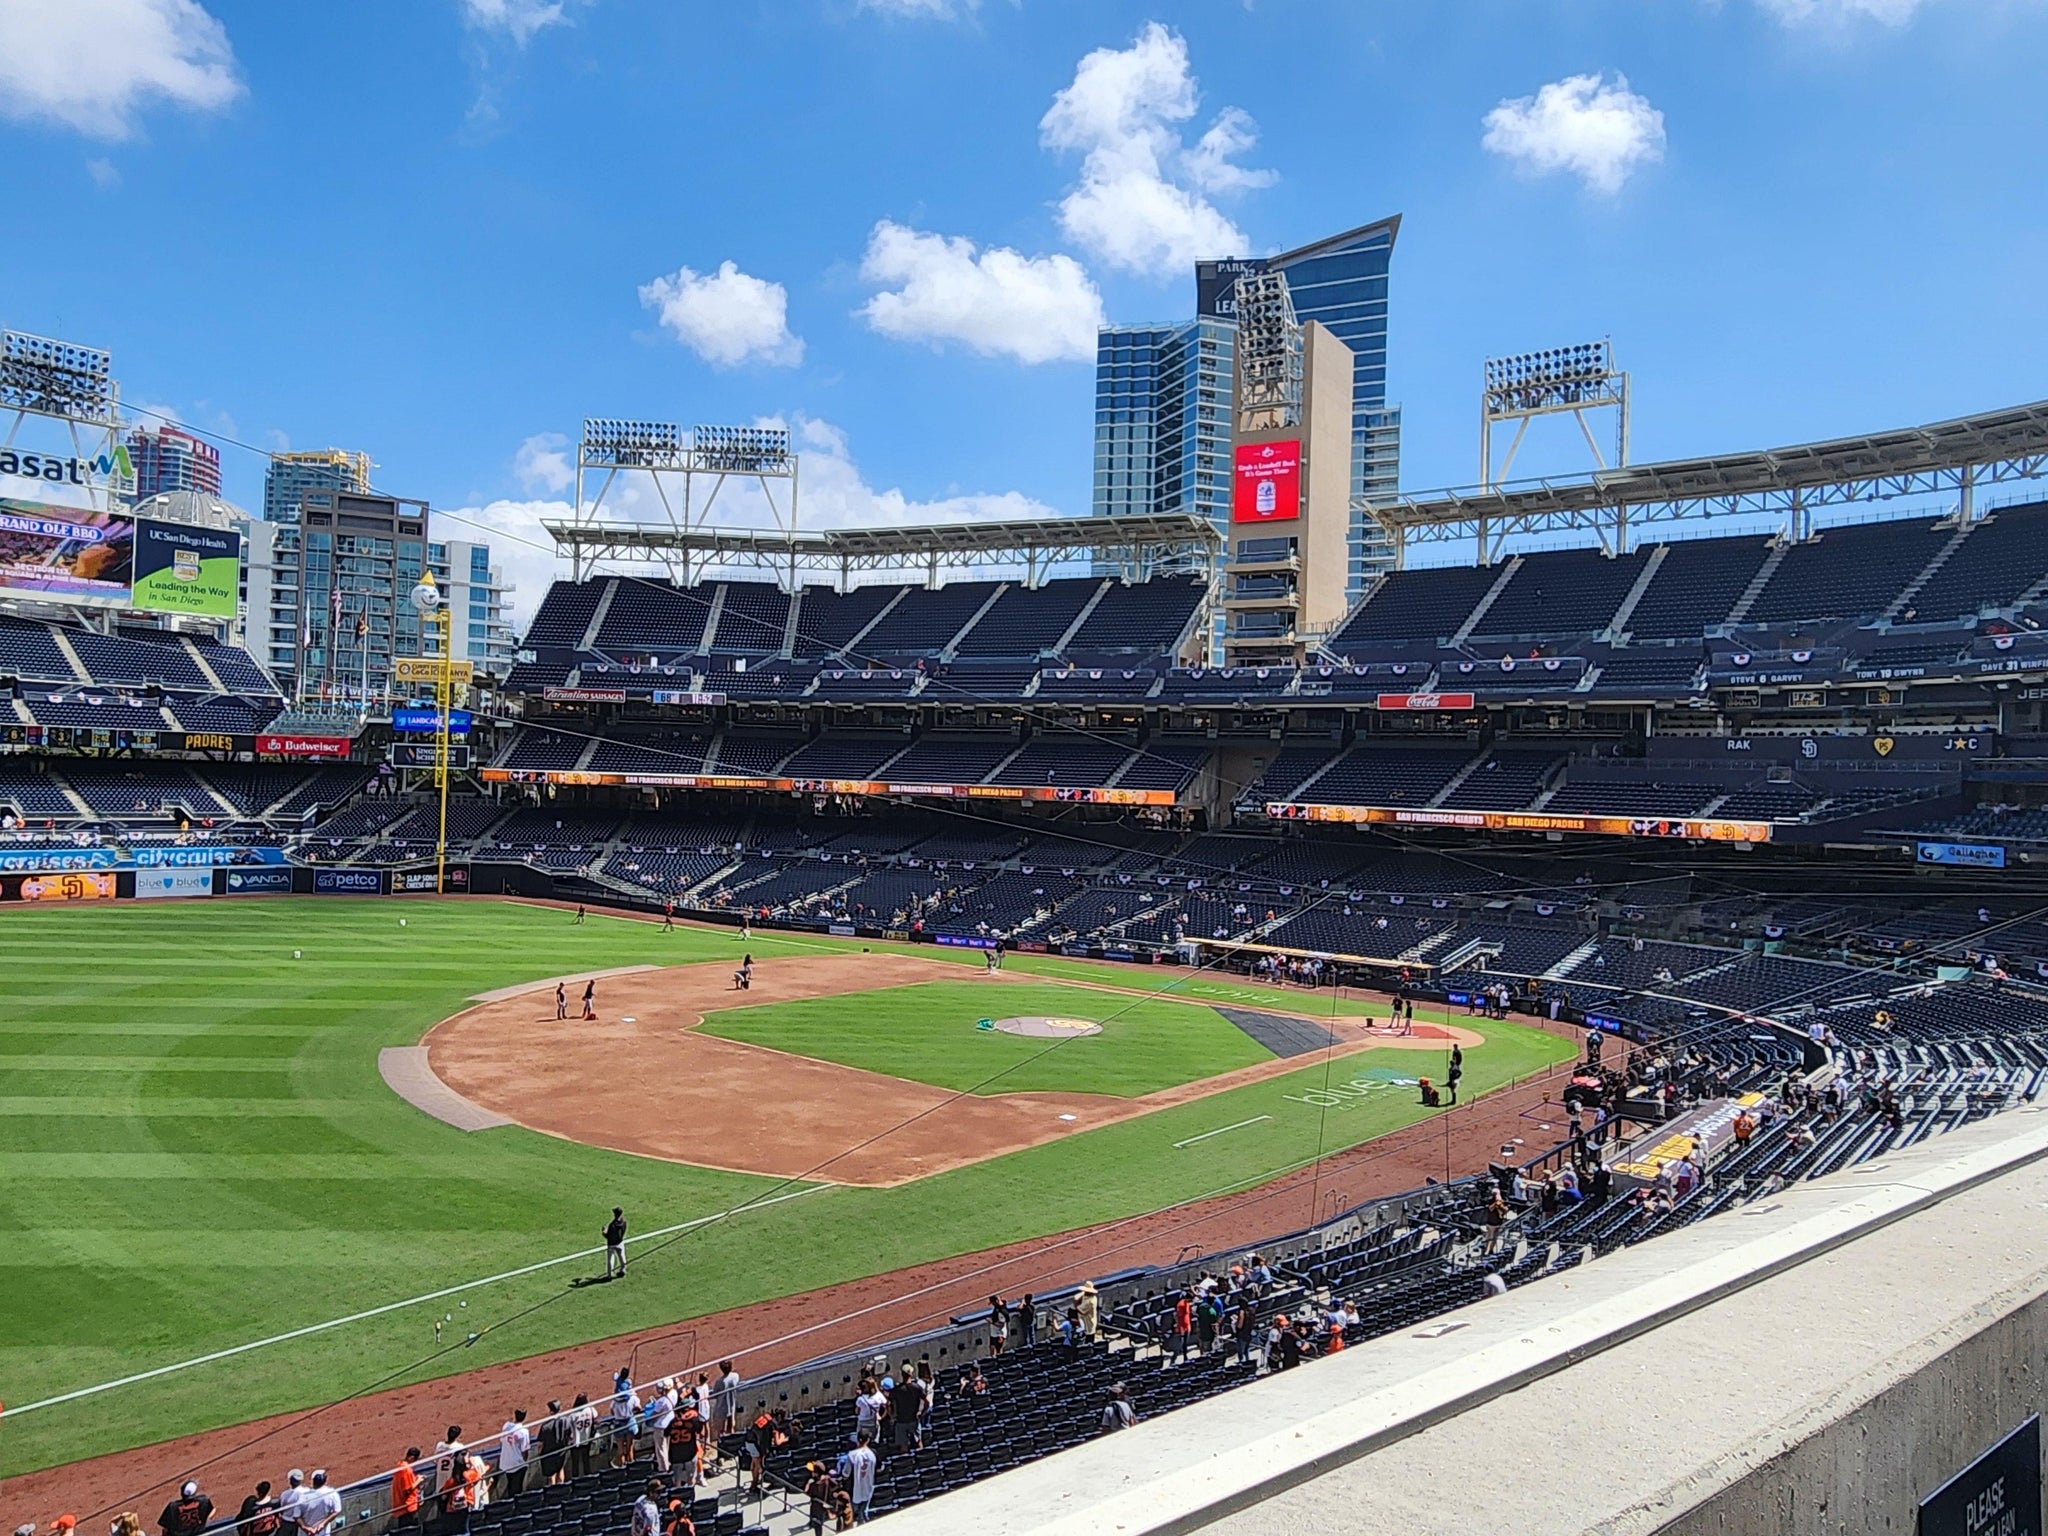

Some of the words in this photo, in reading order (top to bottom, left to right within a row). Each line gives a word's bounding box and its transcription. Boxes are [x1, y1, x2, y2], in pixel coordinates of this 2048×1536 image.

[1217, 263, 1247, 273] PARK
[43, 522, 70, 536] OLE
[72, 525, 99, 539] BBQ
[149, 529, 162, 540] UC
[163, 533, 178, 543] San
[179, 534, 201, 547] Diego
[202, 536, 227, 549] Health
[149, 580, 189, 594] Leading
[190, 583, 206, 594] the
[208, 586, 230, 598] Way
[148, 592, 157, 600] in
[160, 593, 177, 602] San
[180, 596, 204, 606] Diego
[1981, 663, 2003, 672] DAVE
[2006, 660, 2018, 671] 31
[1771, 674, 1803, 683] GARVEY
[1856, 671, 1877, 679] TONY
[1880, 669, 1892, 678] 19
[1894, 668, 1925, 677] GWYNN
[185, 734, 233, 750] PADRES
[284, 740, 341, 752] Budweiser
[1727, 739, 1751, 750] RAK
[625, 776, 638, 784] SAN
[638, 777, 672, 785] FRANCISCO
[673, 778, 696, 786] GIANTS
[713, 779, 726, 787] SAN
[726, 779, 745, 788] DIEGO
[745, 780, 768, 788] PADRES
[889, 784, 901, 793] SAN
[901, 785, 931, 794] FRANCISCO
[932, 786, 953, 795] GIANTS
[968, 786, 981, 795] SAN
[981, 787, 999, 796] DIEGO
[1000, 788, 1023, 797] PADRES
[1396, 812, 1412, 822] SAN
[1412, 813, 1454, 824] FRANCISCO
[1455, 815, 1484, 825] GIANTS
[1485, 815, 1505, 828] VS
[1507, 817, 1523, 826] SAN
[1524, 818, 1550, 828] DIEGO
[1551, 819, 1585, 829] PADRES
[1948, 846, 2000, 860] Gallagher
[138, 878, 162, 887] blue
[176, 877, 199, 887] blue
[243, 874, 290, 884] VANDA
[336, 873, 377, 887] petco
[1282, 1079, 1388, 1107] blue
[440, 1459, 450, 1471] 2
[1967, 1476, 2005, 1536] PLEASE
